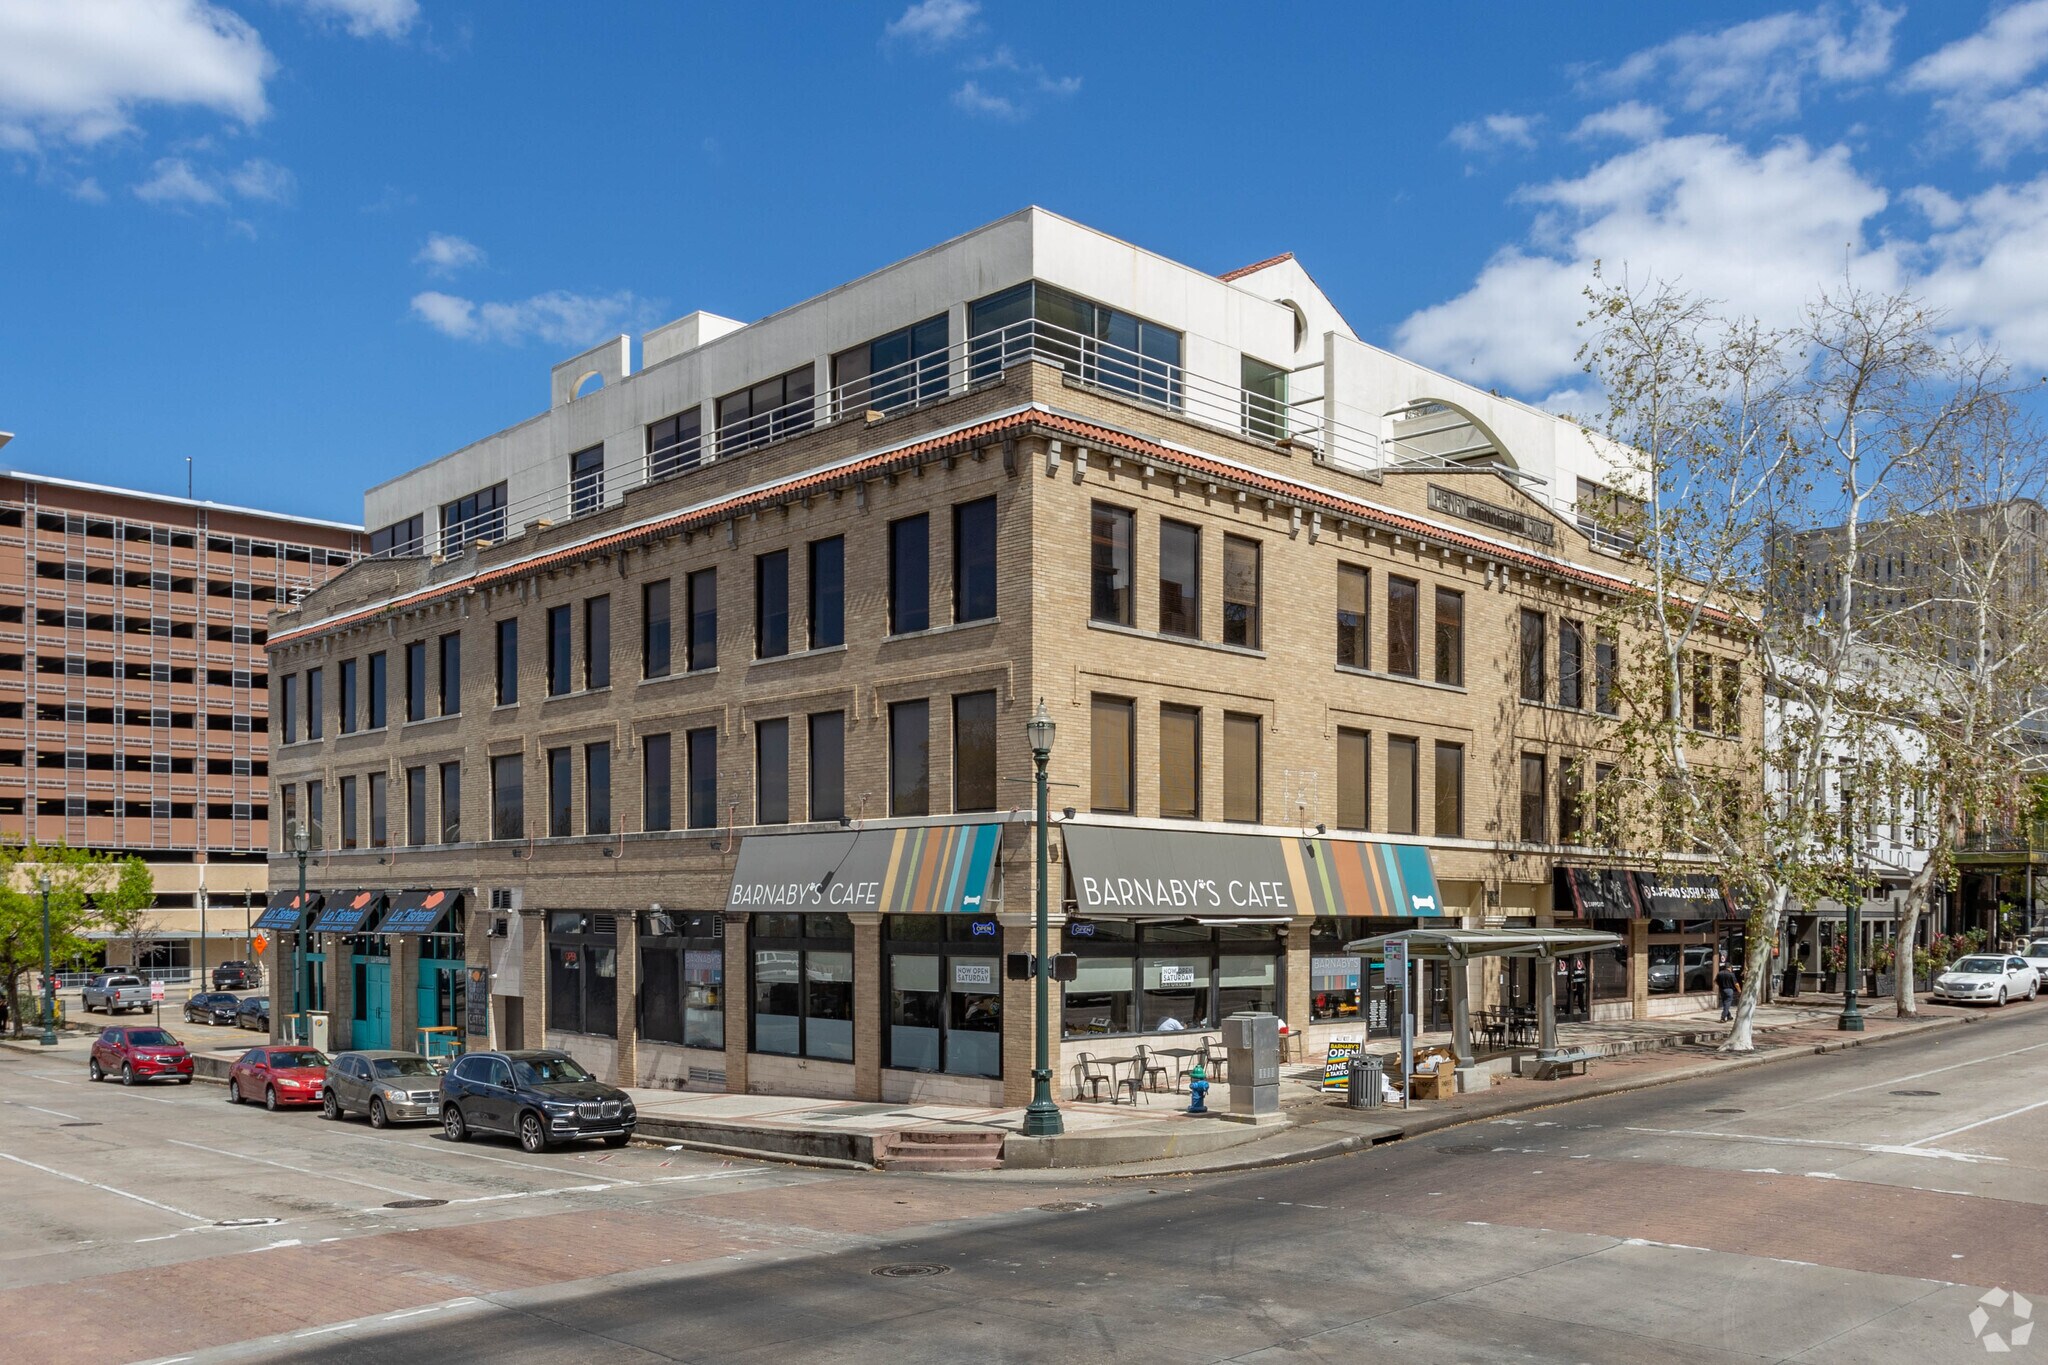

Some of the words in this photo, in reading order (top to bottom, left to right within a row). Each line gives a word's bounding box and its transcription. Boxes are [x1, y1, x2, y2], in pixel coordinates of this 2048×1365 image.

[1434, 490, 1466, 516] HENRY
[829, 882, 879, 905] CAFE
[1083, 877, 1221, 907] BARNABY'S
[1228, 880, 1288, 908] CAFE
[1163, 974, 1192, 982] SATURDAY
[1329, 1049, 1359, 1057] OPEN
[1327, 1063, 1346, 1071] DINE
